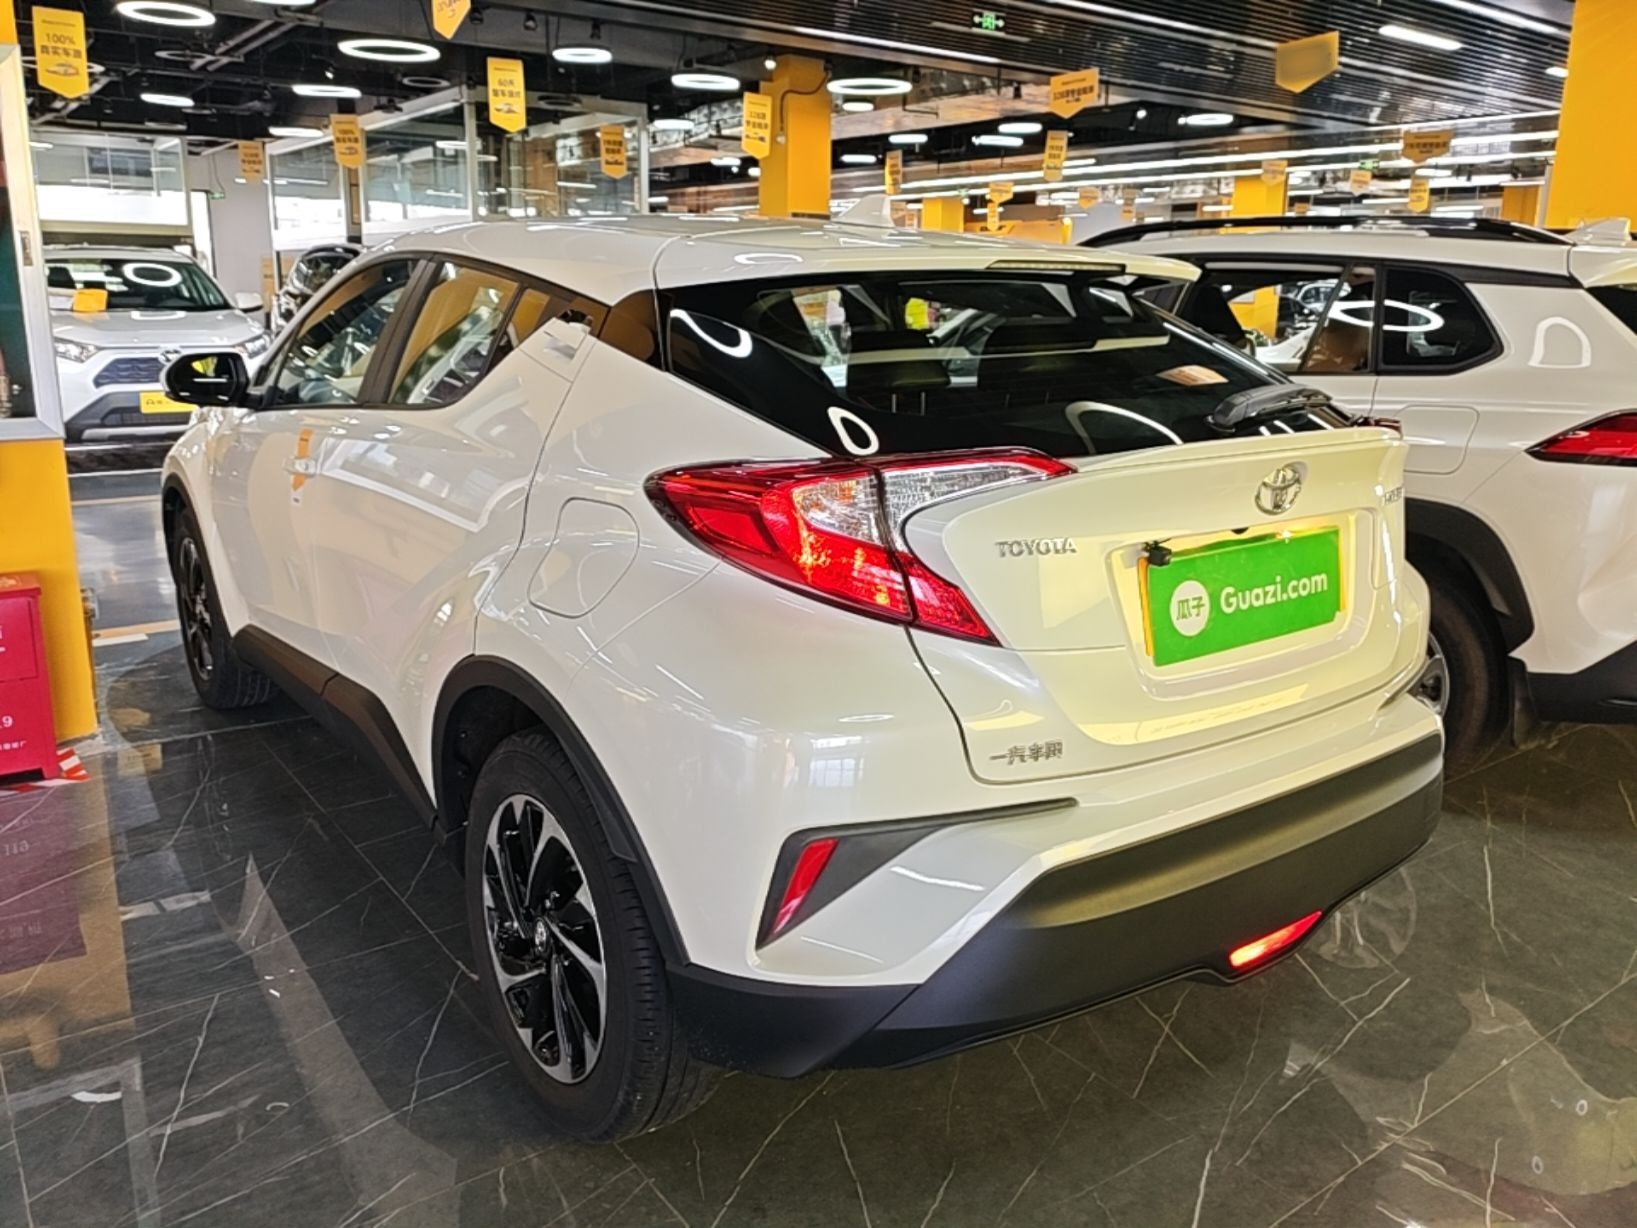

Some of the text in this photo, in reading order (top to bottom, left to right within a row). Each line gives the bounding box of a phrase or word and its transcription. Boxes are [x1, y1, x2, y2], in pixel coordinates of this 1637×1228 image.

[45, 32, 76, 45] 100%
[995, 537, 1077, 558] TOYOTA
[1219, 572, 1328, 615] Guazi.com
[1176, 596, 1206, 621] 瓜子
